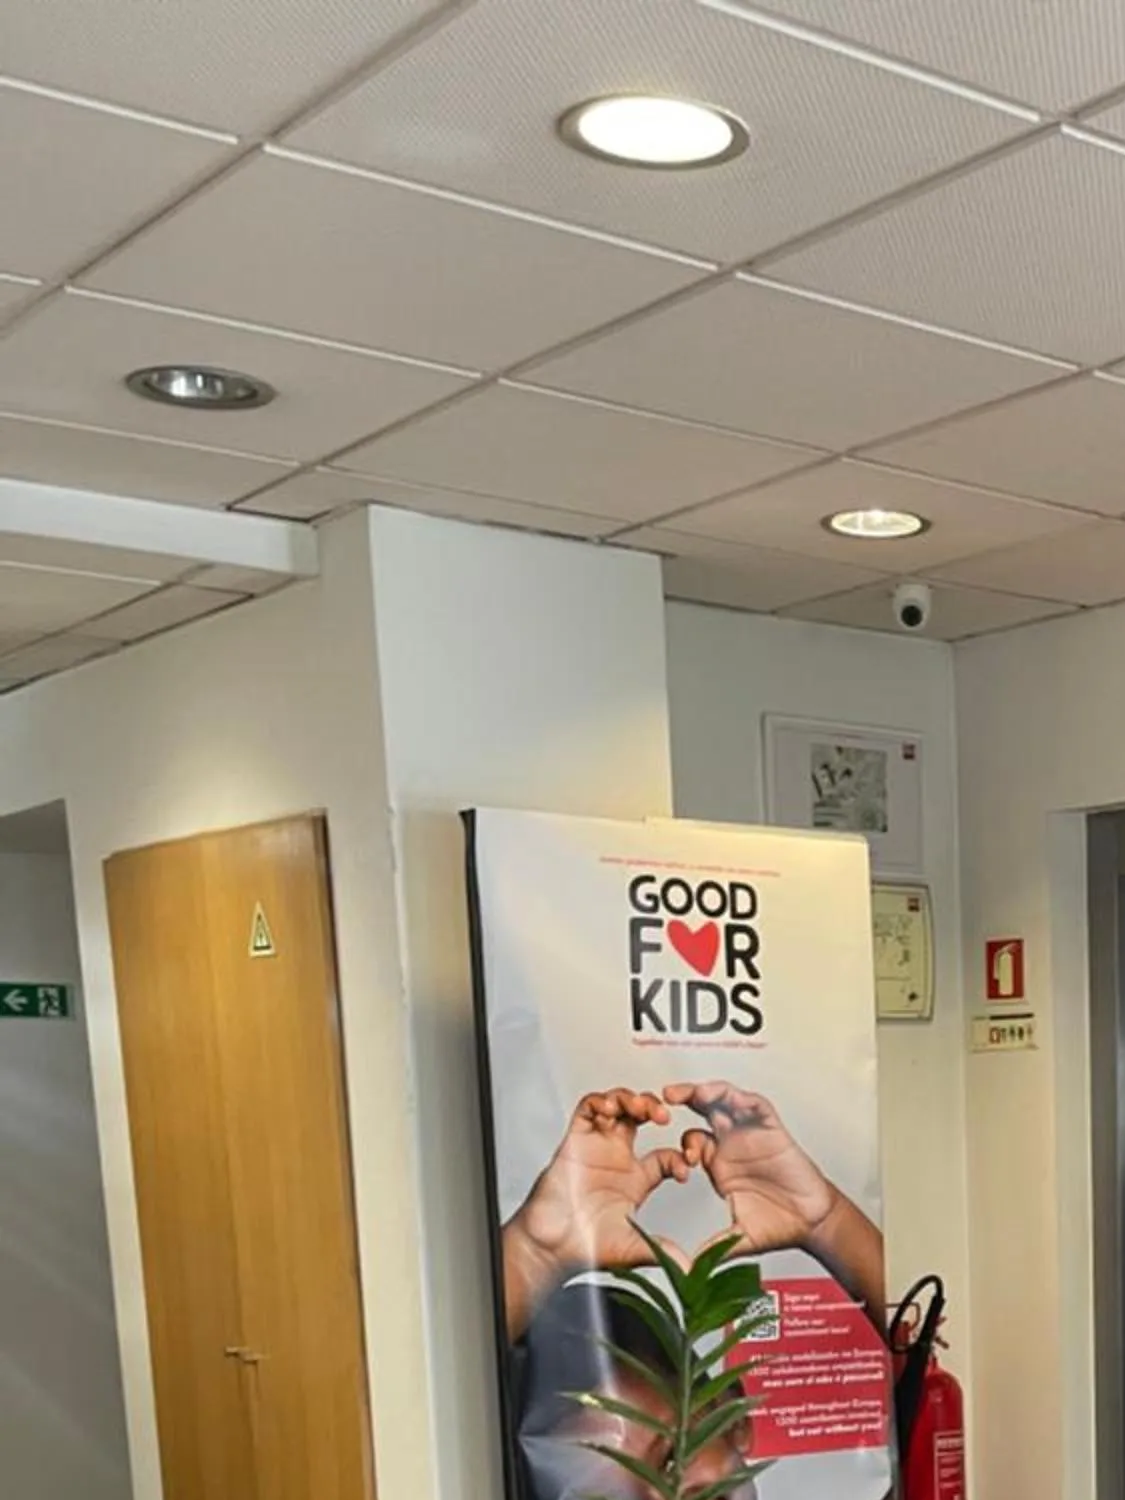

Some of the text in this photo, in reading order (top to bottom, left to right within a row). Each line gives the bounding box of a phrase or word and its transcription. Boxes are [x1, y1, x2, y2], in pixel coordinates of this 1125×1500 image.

[628, 875, 758, 920] GOOD
[629, 917, 760, 980] FR
[630, 978, 763, 1036] KIDS
